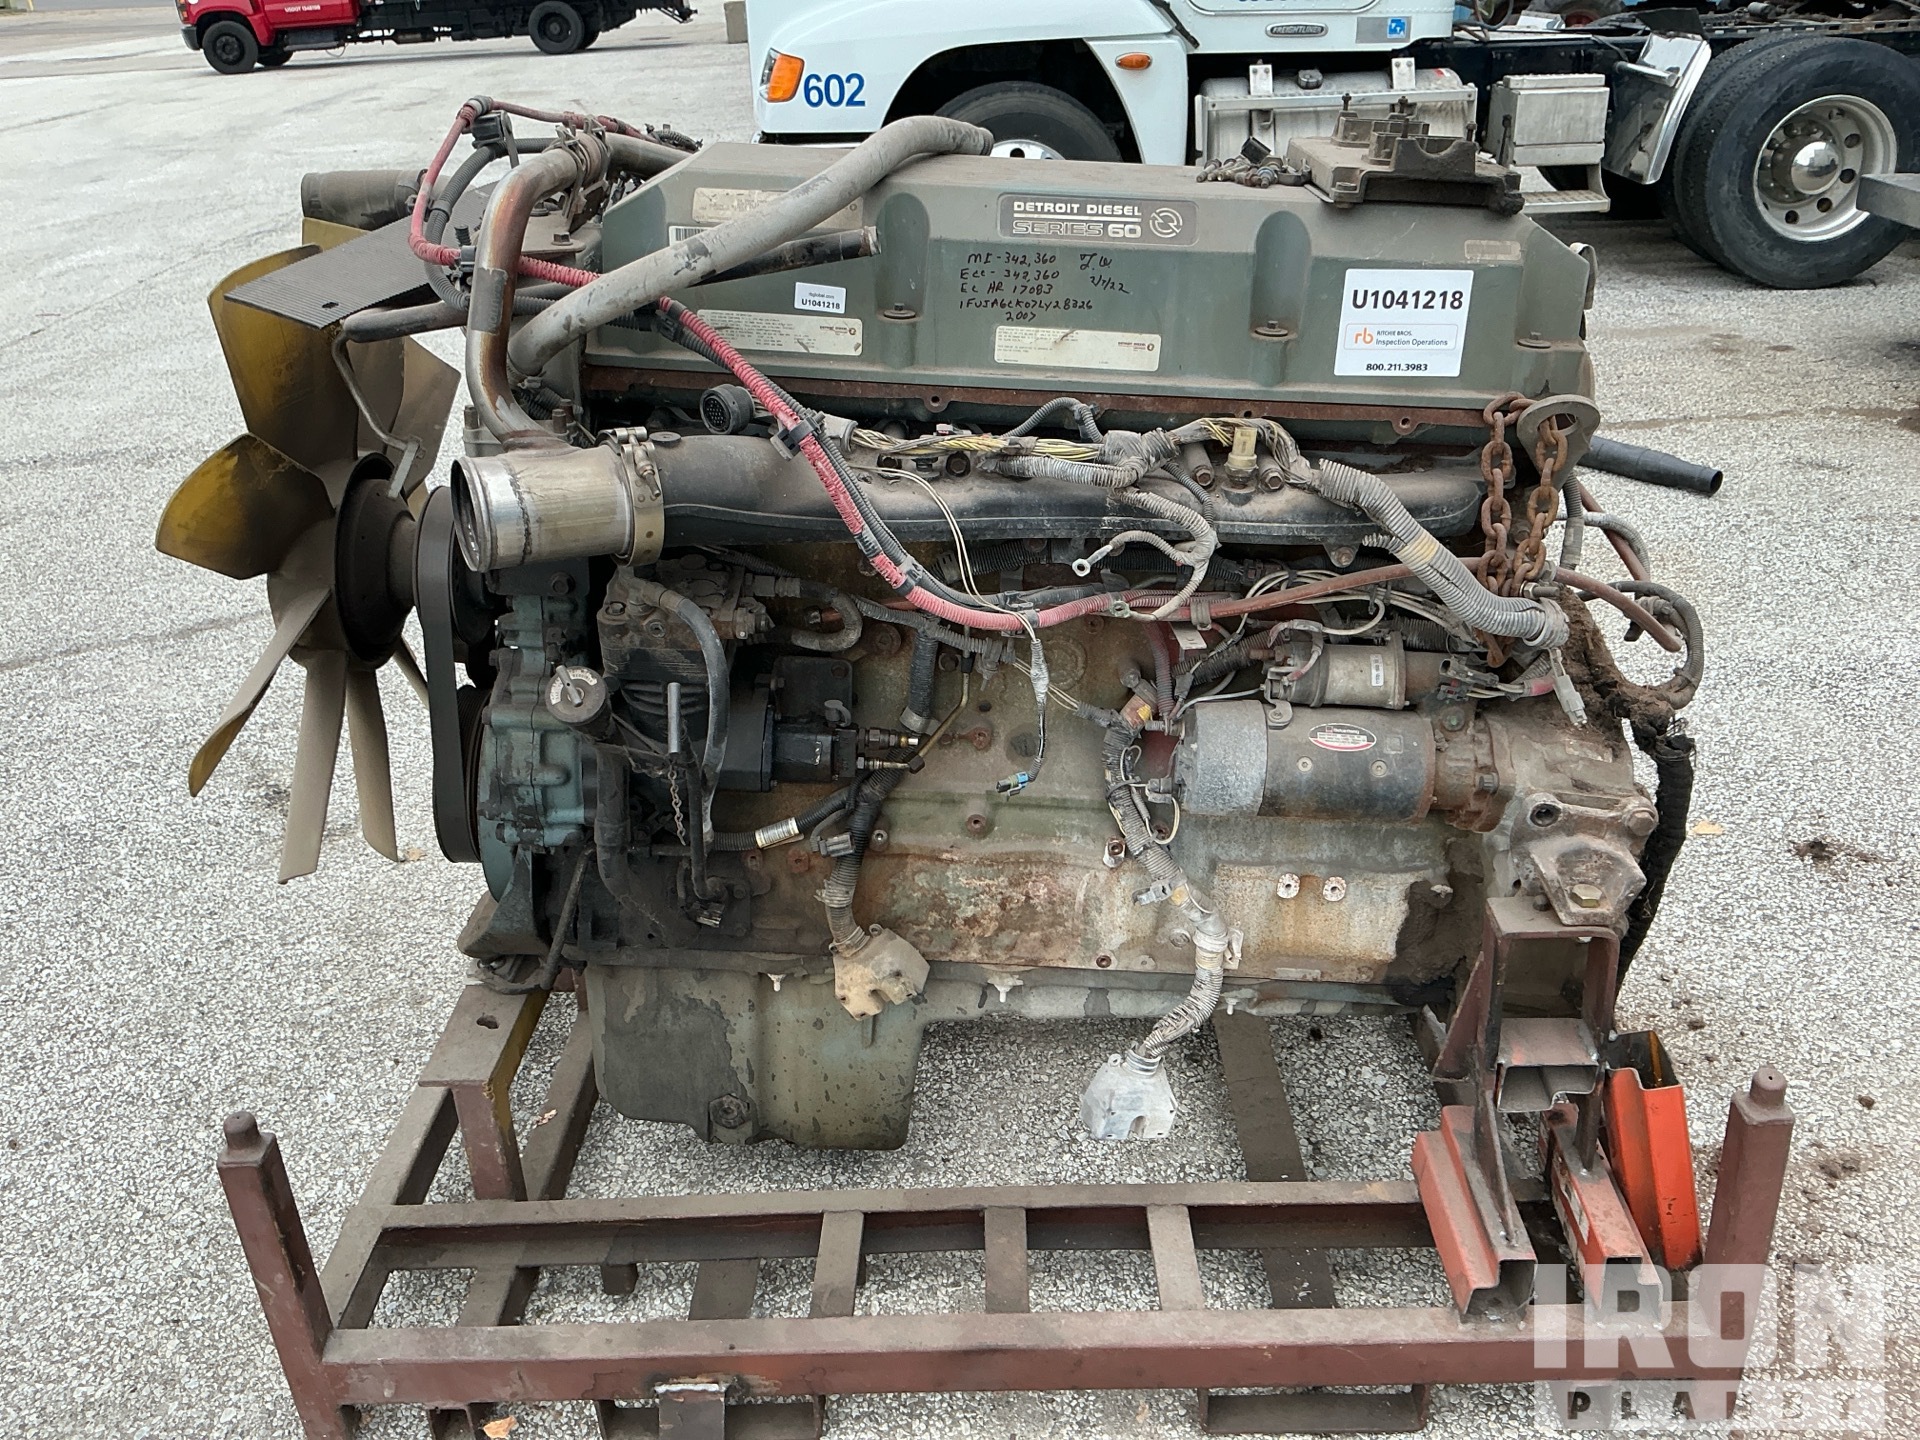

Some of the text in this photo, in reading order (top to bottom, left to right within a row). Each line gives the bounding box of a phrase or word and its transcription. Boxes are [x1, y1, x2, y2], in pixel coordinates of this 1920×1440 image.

[1271, 25, 1323, 34] FREIGHTLINER
[804, 73, 865, 107] 602
[1013, 201, 1142, 216] DETROIT DIESEL
[1012, 220, 1142, 238] SERIES 60
[987, 281, 1004, 294] HR
[1012, 283, 1054, 295] 17083
[801, 298, 841, 310] U1041218
[1352, 289, 1464, 310] U1041218
[1005, 311, 1037, 323] 2007
[1354, 327, 1374, 345] rb
[1376, 338, 1448, 347] Inspection Operations
[1365, 363, 1428, 372] 800.211.3983
